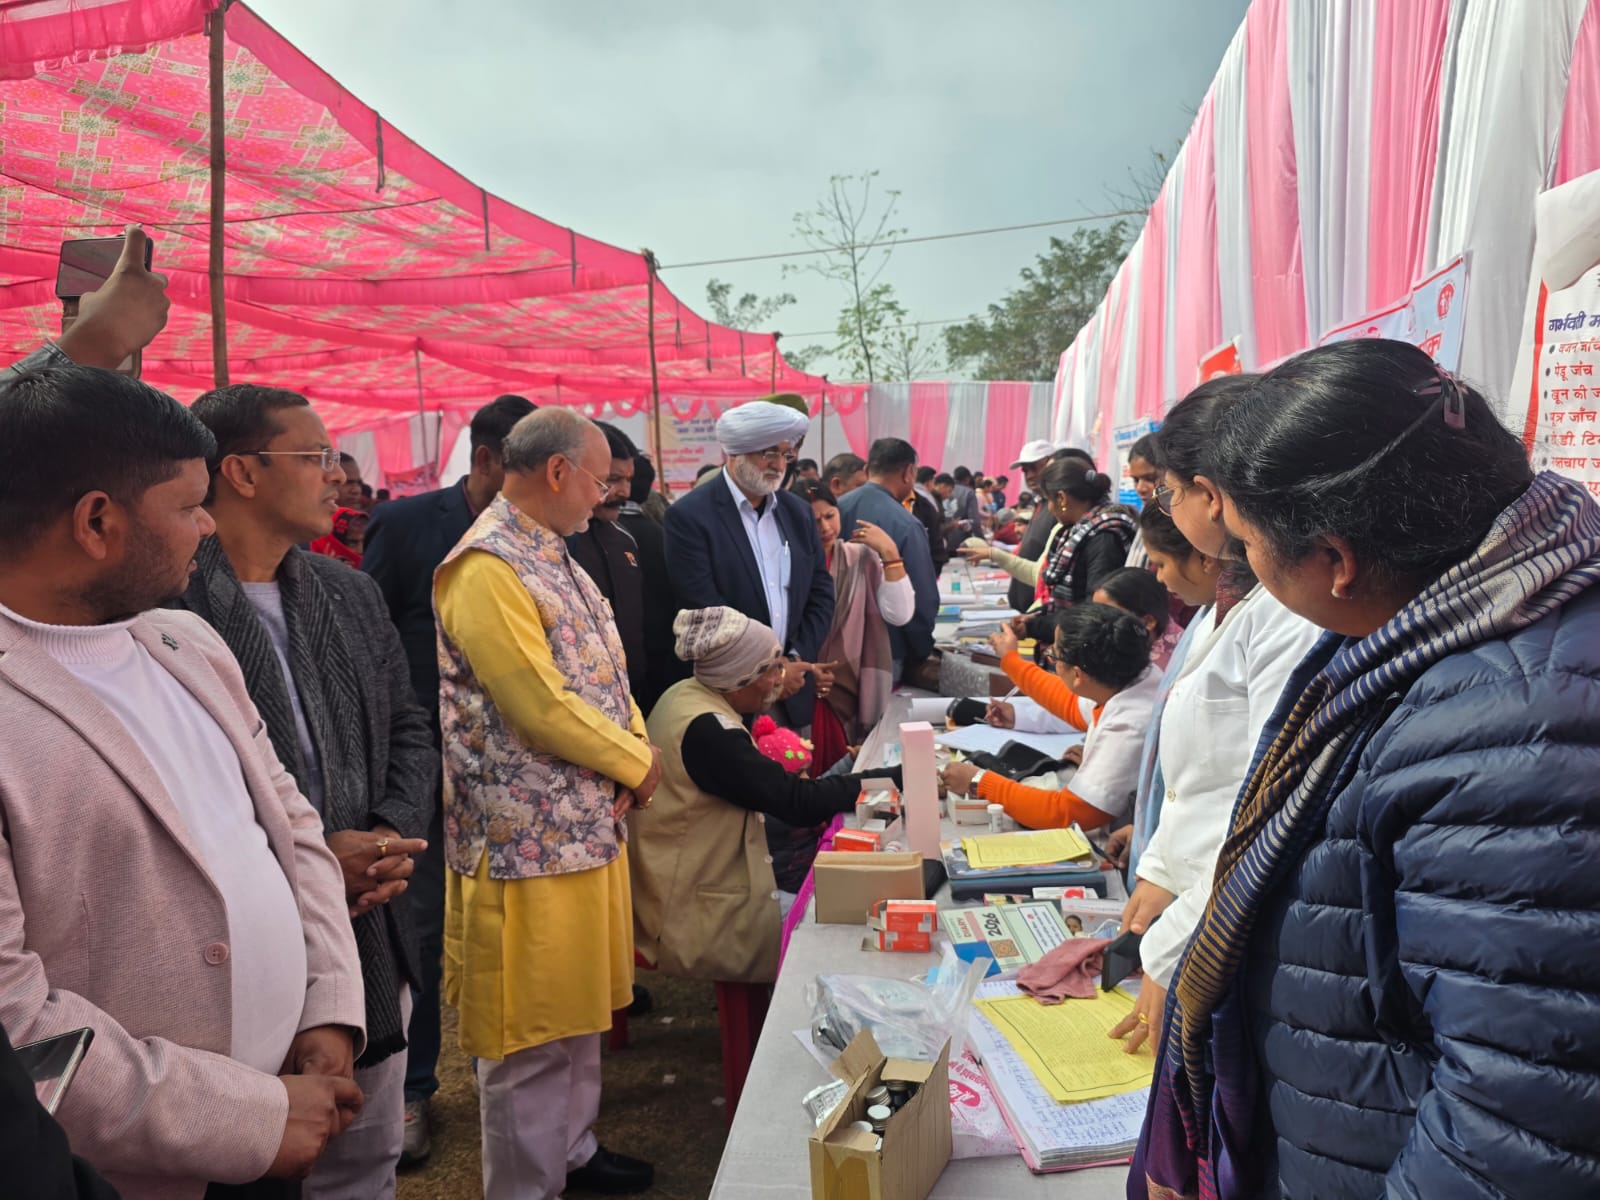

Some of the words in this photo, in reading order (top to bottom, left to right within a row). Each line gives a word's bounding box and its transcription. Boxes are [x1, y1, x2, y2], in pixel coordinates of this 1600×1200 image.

[1549, 310, 1586, 332] गर्भवती
[1589, 315, 1600, 327] म
[1573, 384, 1587, 399] की
[1591, 387, 1600, 398] ज
[1591, 457, 1600, 468] ज
[982, 912, 1003, 937] 2026
